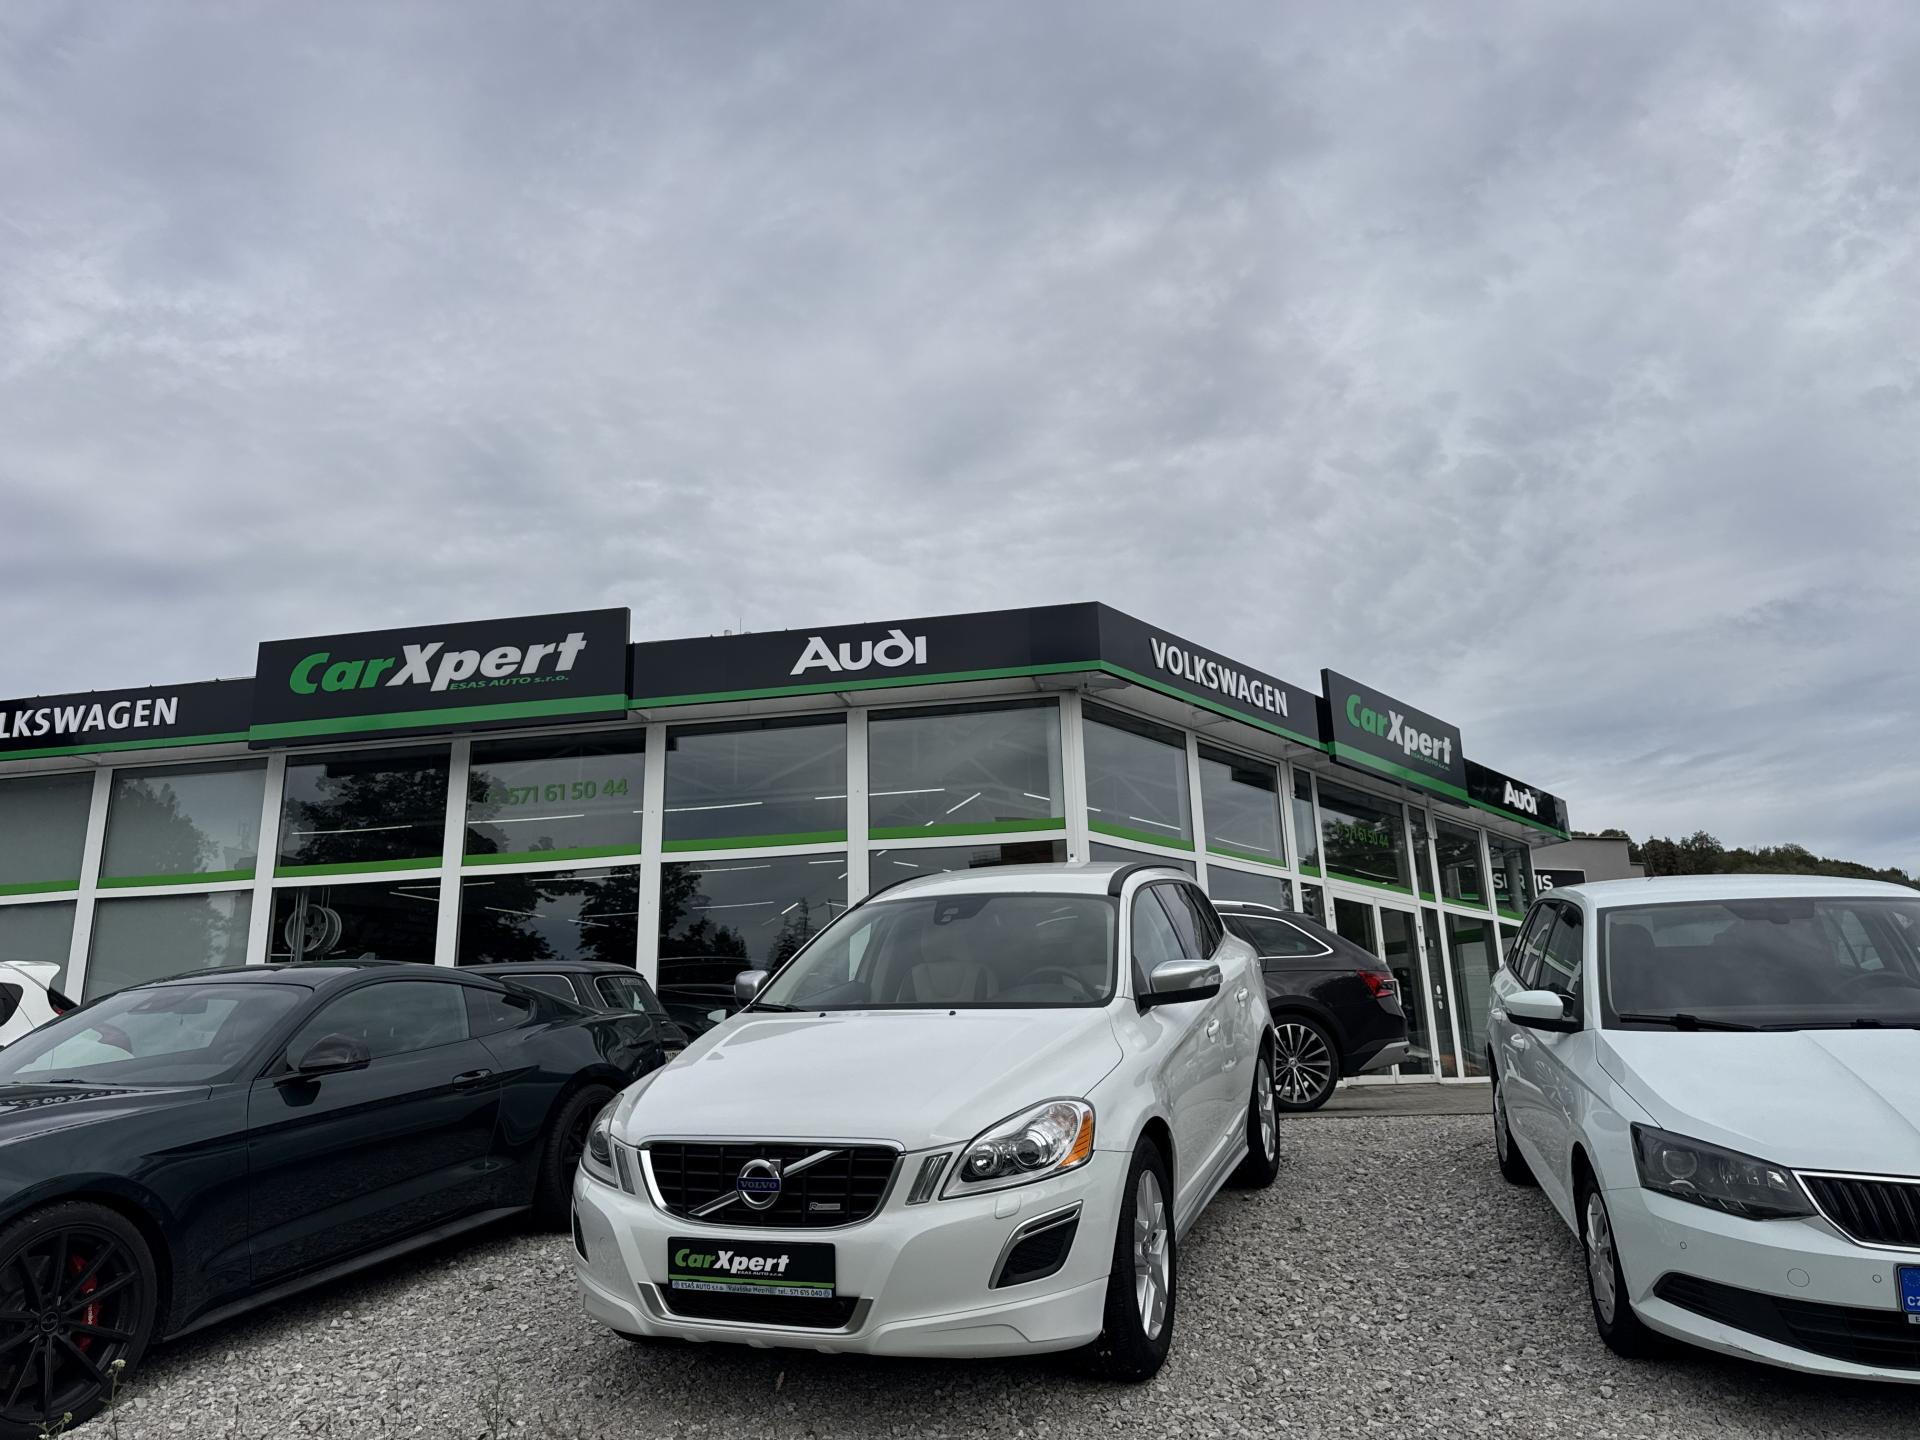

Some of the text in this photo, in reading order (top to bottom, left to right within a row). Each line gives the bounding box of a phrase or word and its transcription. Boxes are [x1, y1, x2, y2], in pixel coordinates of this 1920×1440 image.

[289, 632, 587, 694] CarXpert
[790, 629, 927, 675] Audi
[449, 674, 569, 690] ESAS AUTO s.r.o.
[1150, 637, 1288, 717] VOLKSWAGEN
[0, 697, 178, 738] LKSWAGEN
[1346, 694, 1452, 765] CarXpert
[508, 777, 629, 805] 571 61 50 44
[1504, 780, 1538, 815] Audi
[740, 1180, 777, 1189] VOLVO
[674, 1248, 790, 1274] CarXpert
